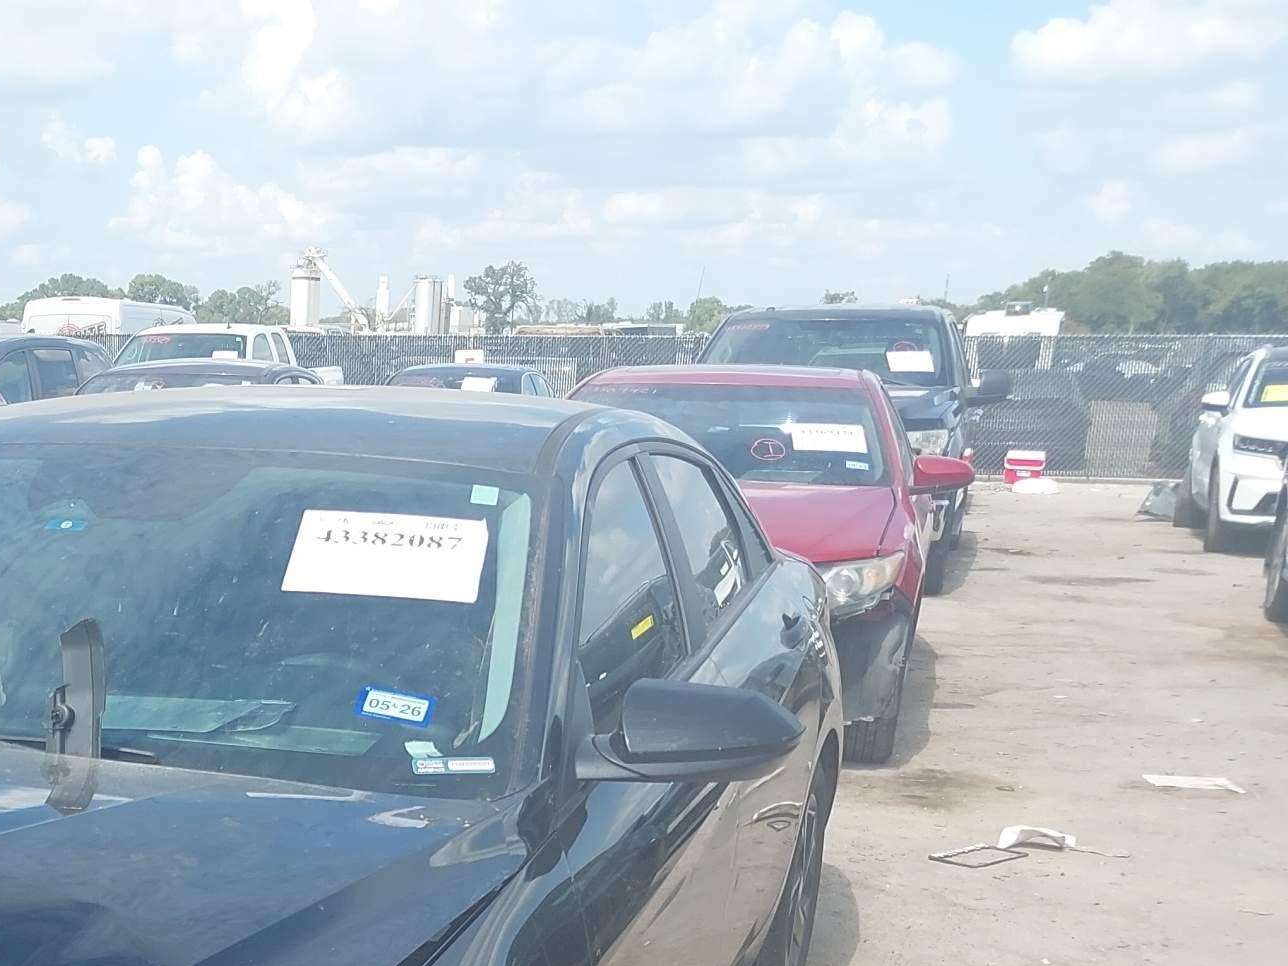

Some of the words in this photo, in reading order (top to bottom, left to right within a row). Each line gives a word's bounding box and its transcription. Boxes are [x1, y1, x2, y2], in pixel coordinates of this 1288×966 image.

[316, 528, 463, 551] 43382087
[368, 697, 391, 712] 05
[399, 703, 423, 718] 26
